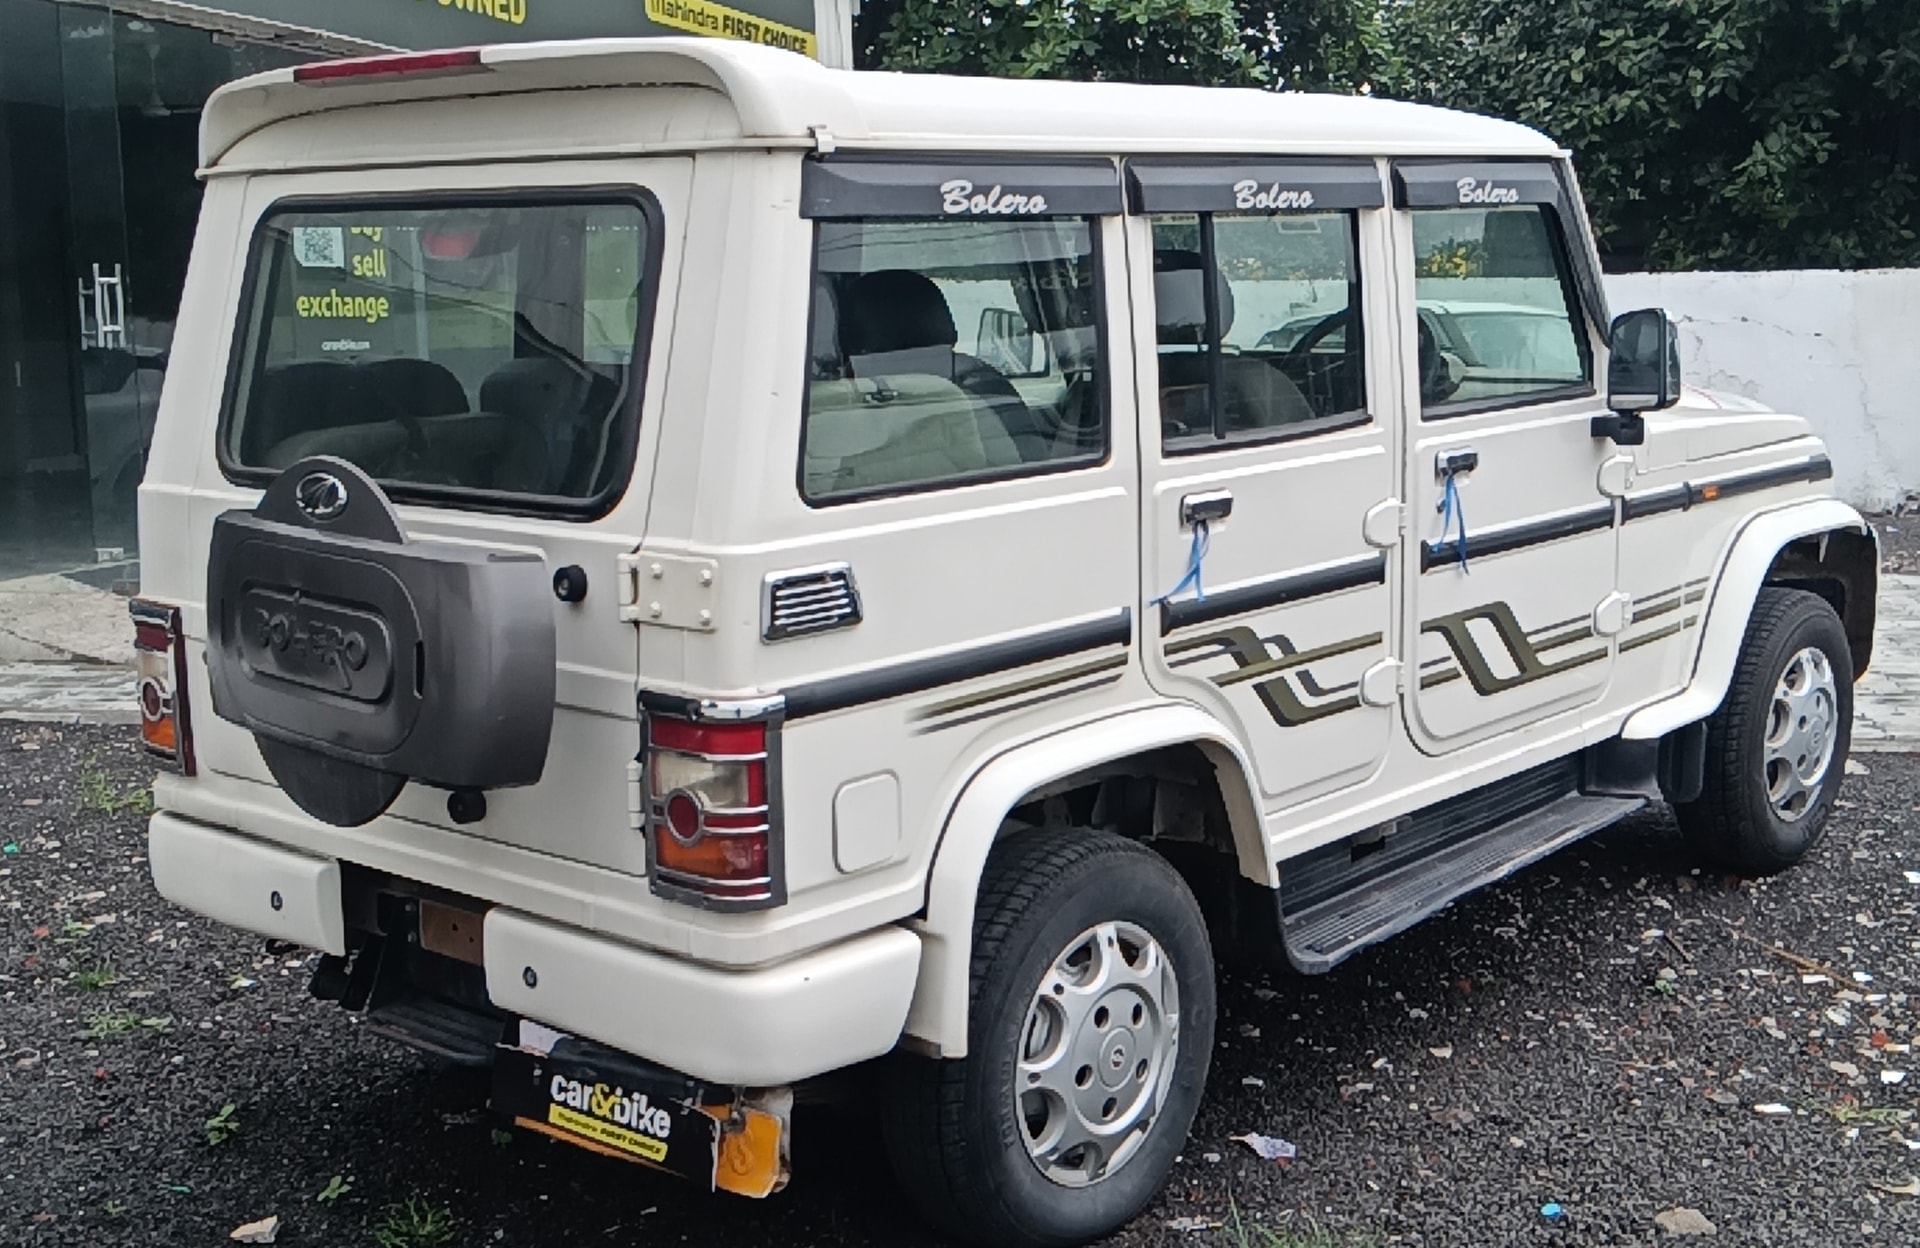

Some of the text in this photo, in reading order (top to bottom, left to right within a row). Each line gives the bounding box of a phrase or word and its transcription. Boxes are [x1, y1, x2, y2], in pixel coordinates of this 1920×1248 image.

[722, 14, 760, 43] FIRST
[763, 26, 808, 54] CHOICE
[940, 179, 1048, 214] Bolero
[1233, 179, 1315, 209] Bolero
[1456, 176, 1519, 203] Bolero
[351, 248, 387, 278] sell
[296, 287, 389, 323] exchange
